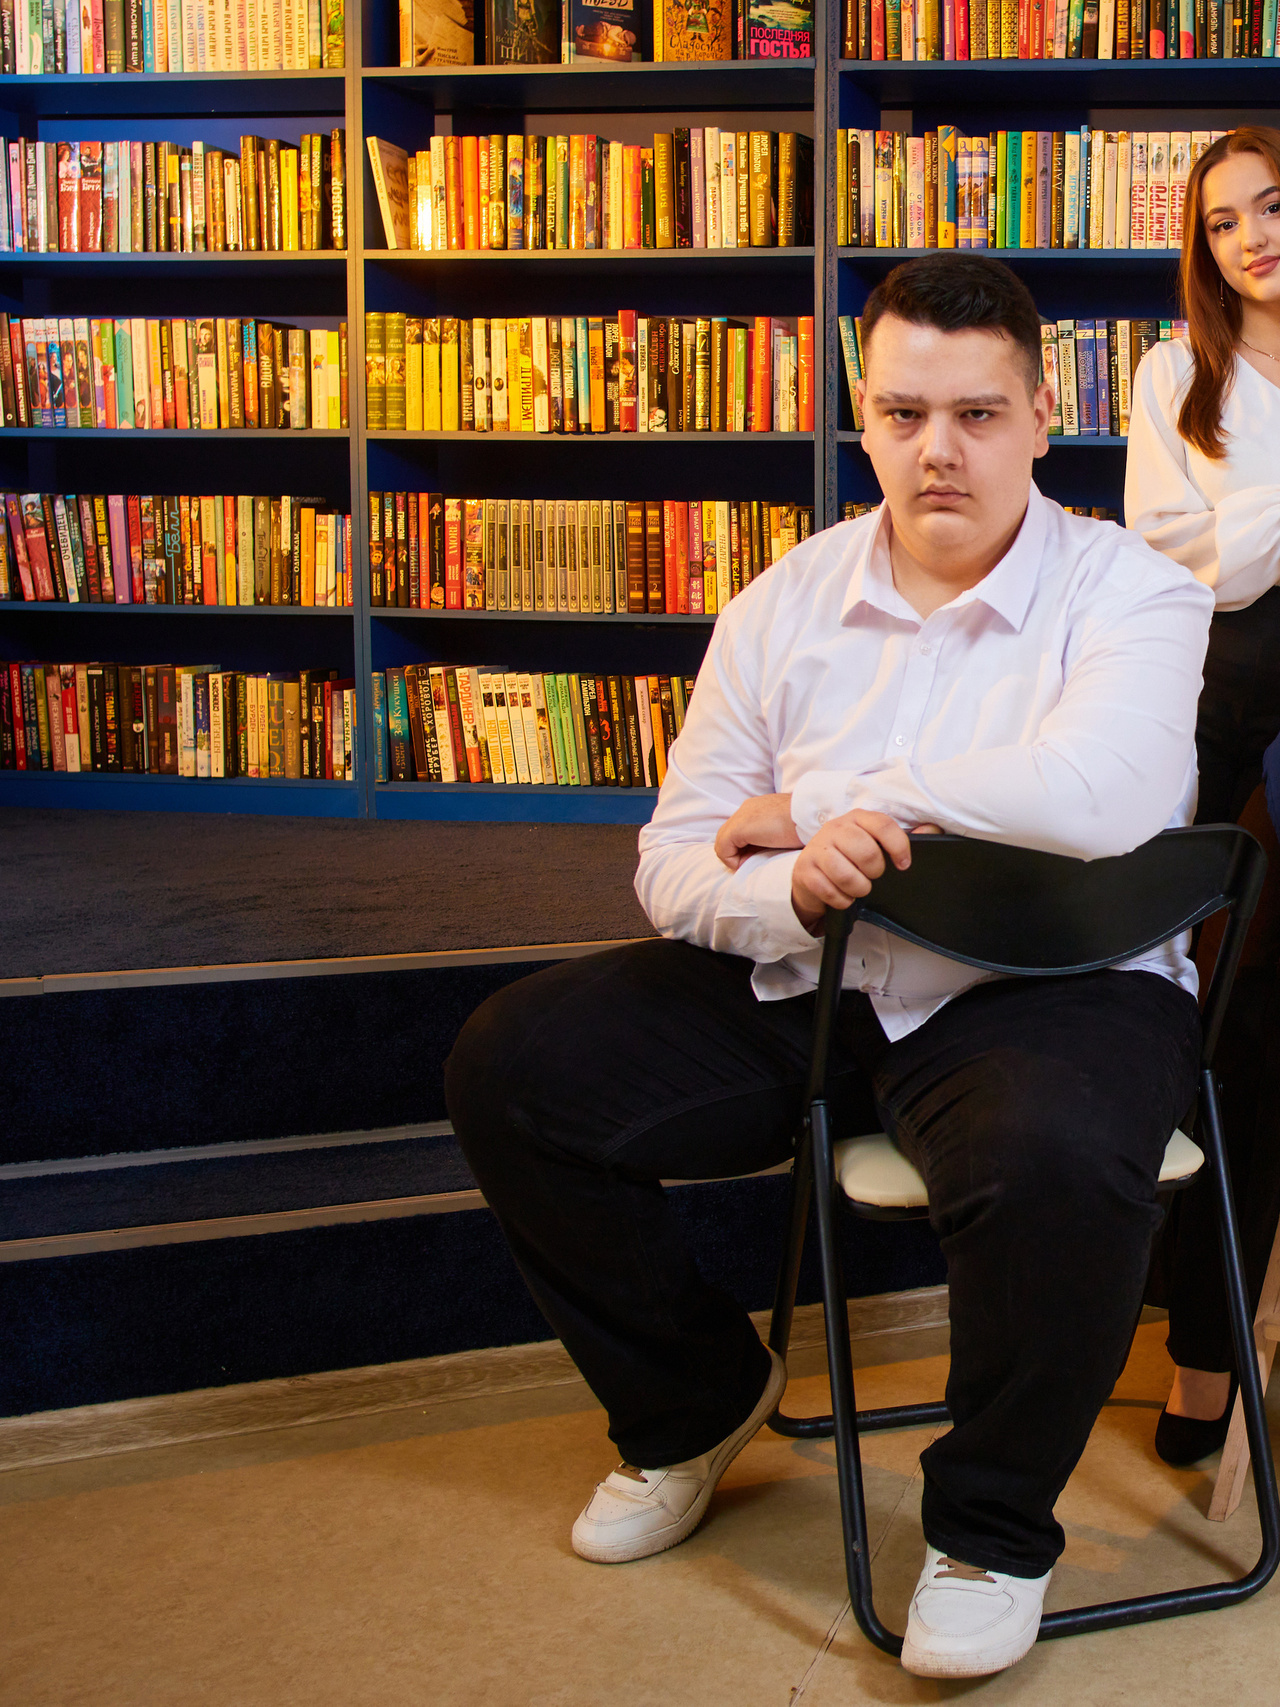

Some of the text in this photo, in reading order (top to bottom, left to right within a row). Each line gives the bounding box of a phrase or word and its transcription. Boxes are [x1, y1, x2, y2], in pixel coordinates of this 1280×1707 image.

[186, 4, 195, 64] САНДРА БРАУН
[238, 31, 246, 63] САНДРА
[750, 27, 811, 42] ПОСЛЕДНЯЯ
[1210, 2, 1219, 54] ДАНИЭЛЬ ЖИРАР
[750, 39, 811, 60] ГОСТЬЯ
[659, 143, 668, 183] ВОЙНЫ
[753, 135, 762, 173] ГАМИЛЬТОН
[760, 135, 768, 156] ЛОРЕЛ
[1052, 142, 1064, 192] ДАРИЕН
[332, 177, 344, 236] ЗАГОВОР
[547, 185, 555, 232] ЛЕГЕНДА
[739, 173, 748, 206] Лучшее
[739, 214, 747, 233] тебе
[1132, 185, 1145, 241] ИСИГУРО
[1149, 185, 1166, 241] ИСИГУРО
[248, 321, 256, 363] КАНЗАСА
[650, 330, 658, 366] натура
[841, 321, 851, 358] МЕРТВОЕ
[847, 330, 856, 357] ОЗЕРО
[17, 389, 25, 422] ИСЧЕЗНУ
[521, 378, 531, 421] ГРИШЭМ
[57, 513, 69, 560] ОЧЕВИДЕЦ
[448, 524, 458, 555] AMORE
[86, 550, 98, 595] ЗНАКИ
[106, 691, 115, 729] ТЕМНЫЙ
[423, 679, 434, 725] ХОРОВОД
[460, 675, 474, 725] ГАРДИНЕР
[581, 680, 591, 716] ГАМИЛЬТОН
[588, 680, 596, 699] ЛОРЕЛ
[52, 701, 62, 763] НЕЖНАЯ ВОЙНА
[488, 720, 499, 775] ФИЛИП ГУДЕН
[502, 719, 514, 774] ФИЛИП ГУДЕН
[515, 719, 527, 774] ФИЛИП ГУДЕН
[527, 720, 540, 774] ФИЛИП ГУДЕН
[426, 739, 434, 774] АНДРЕАС
[431, 737, 440, 774] ГРУБЕР
